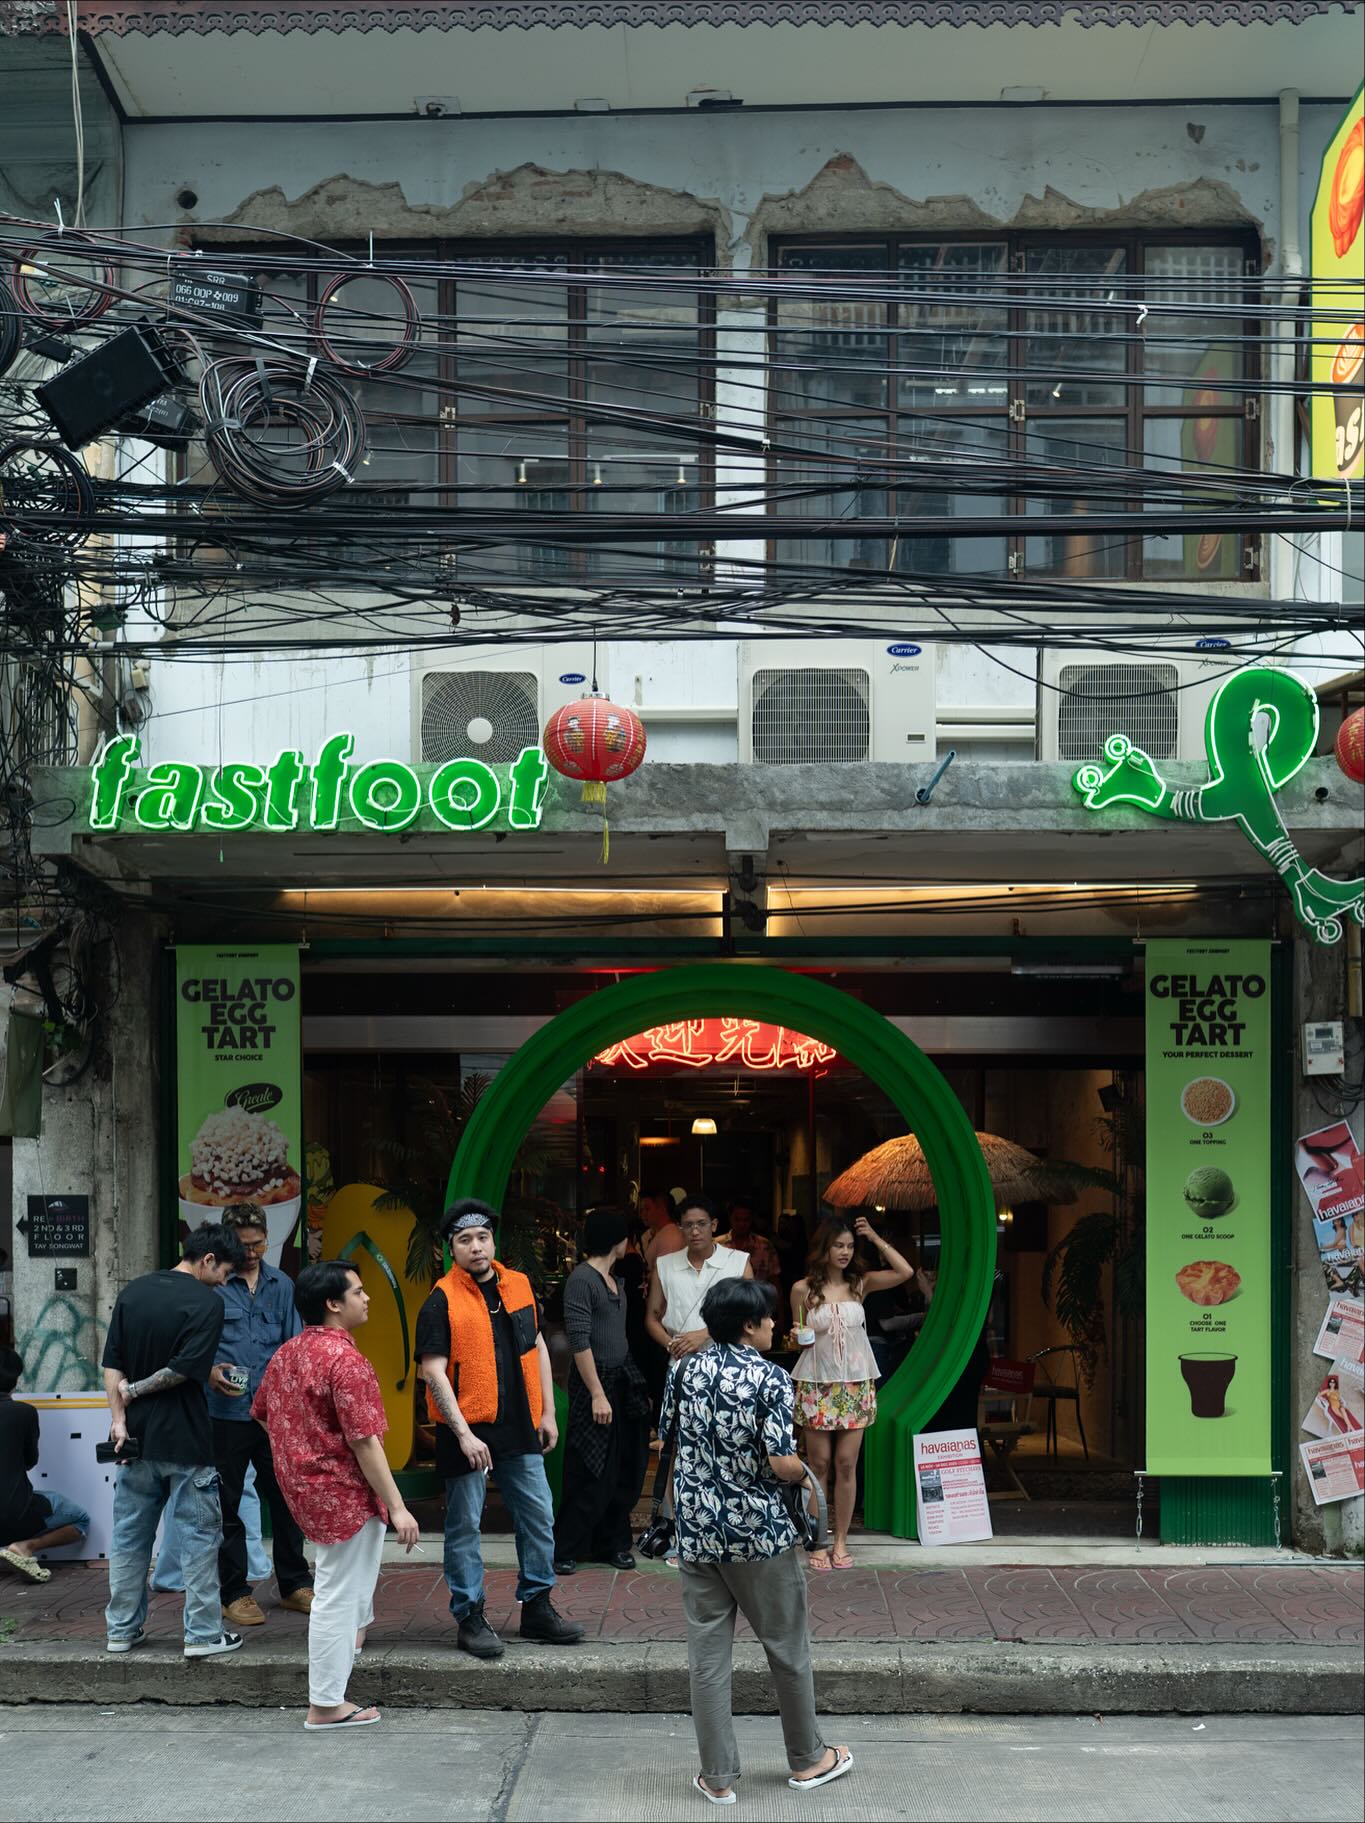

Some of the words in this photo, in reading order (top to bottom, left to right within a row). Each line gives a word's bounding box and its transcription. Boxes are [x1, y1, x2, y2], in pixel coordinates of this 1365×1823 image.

[90, 731, 549, 832] fastfoot
[181, 977, 296, 1002] GELATO
[1150, 974, 1266, 998] GELATO
[210, 1002, 268, 1026] EGG
[1179, 998, 1238, 1022] EGG
[201, 1025, 276, 1049] TART
[1170, 1022, 1246, 1046] TART
[214, 1054, 234, 1062] STAR
[234, 1054, 264, 1062] CHOICE
[920, 1439, 977, 1455] havaianas
